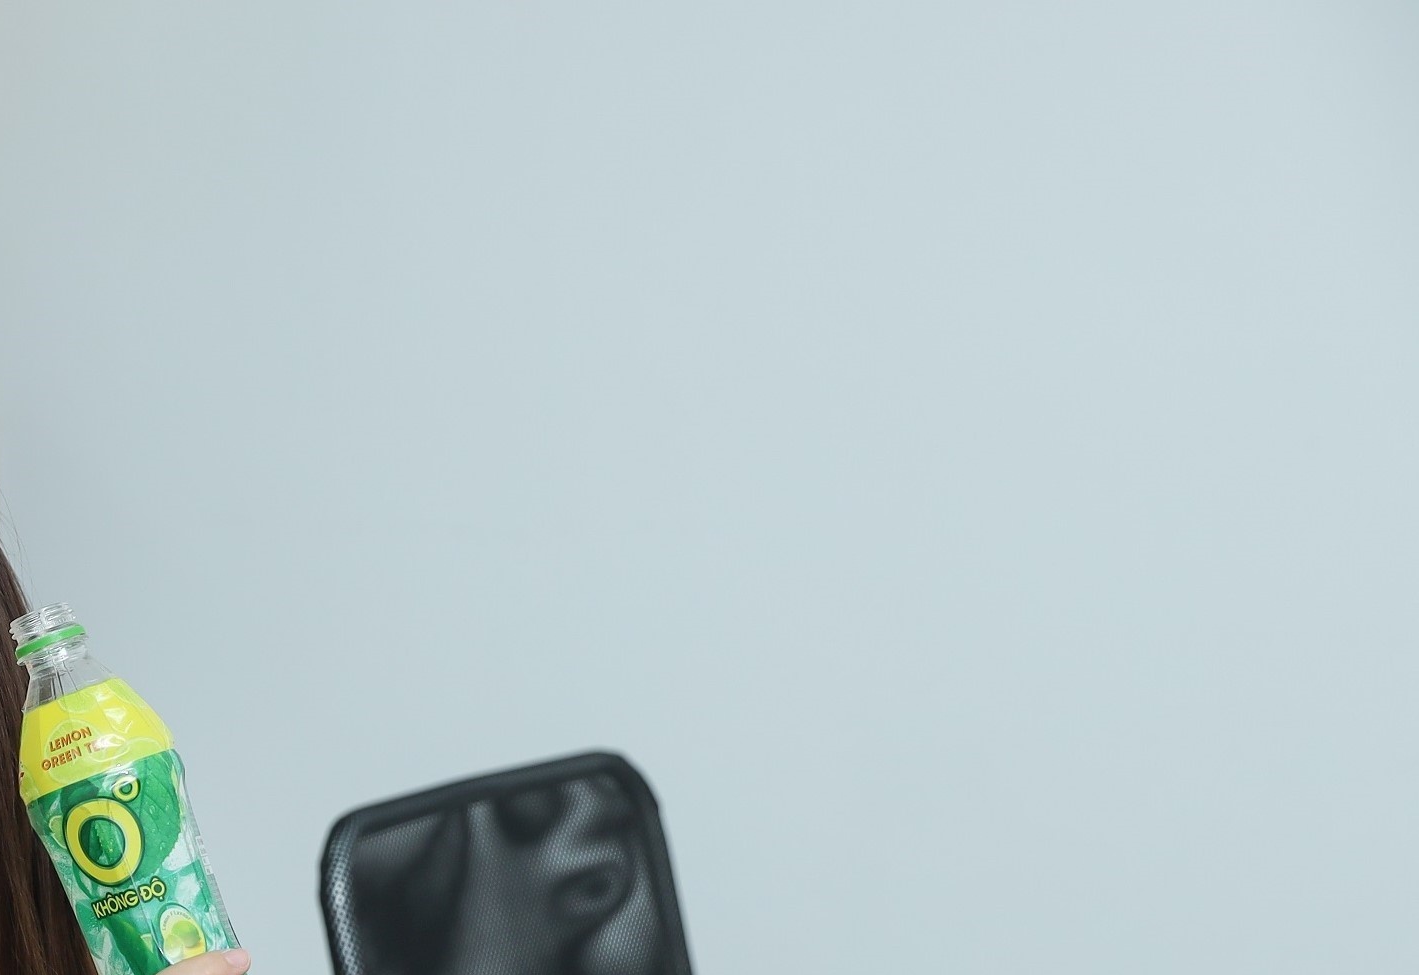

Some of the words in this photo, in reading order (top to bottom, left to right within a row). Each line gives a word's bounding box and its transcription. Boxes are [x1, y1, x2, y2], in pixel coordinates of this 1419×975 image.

[41, 746, 83, 771] GREEN
[83, 738, 110, 754] TE
[49, 726, 92, 753] LEMON
[91, 885, 139, 921] KHÔNG
[138, 876, 168, 904] ĐỘ
